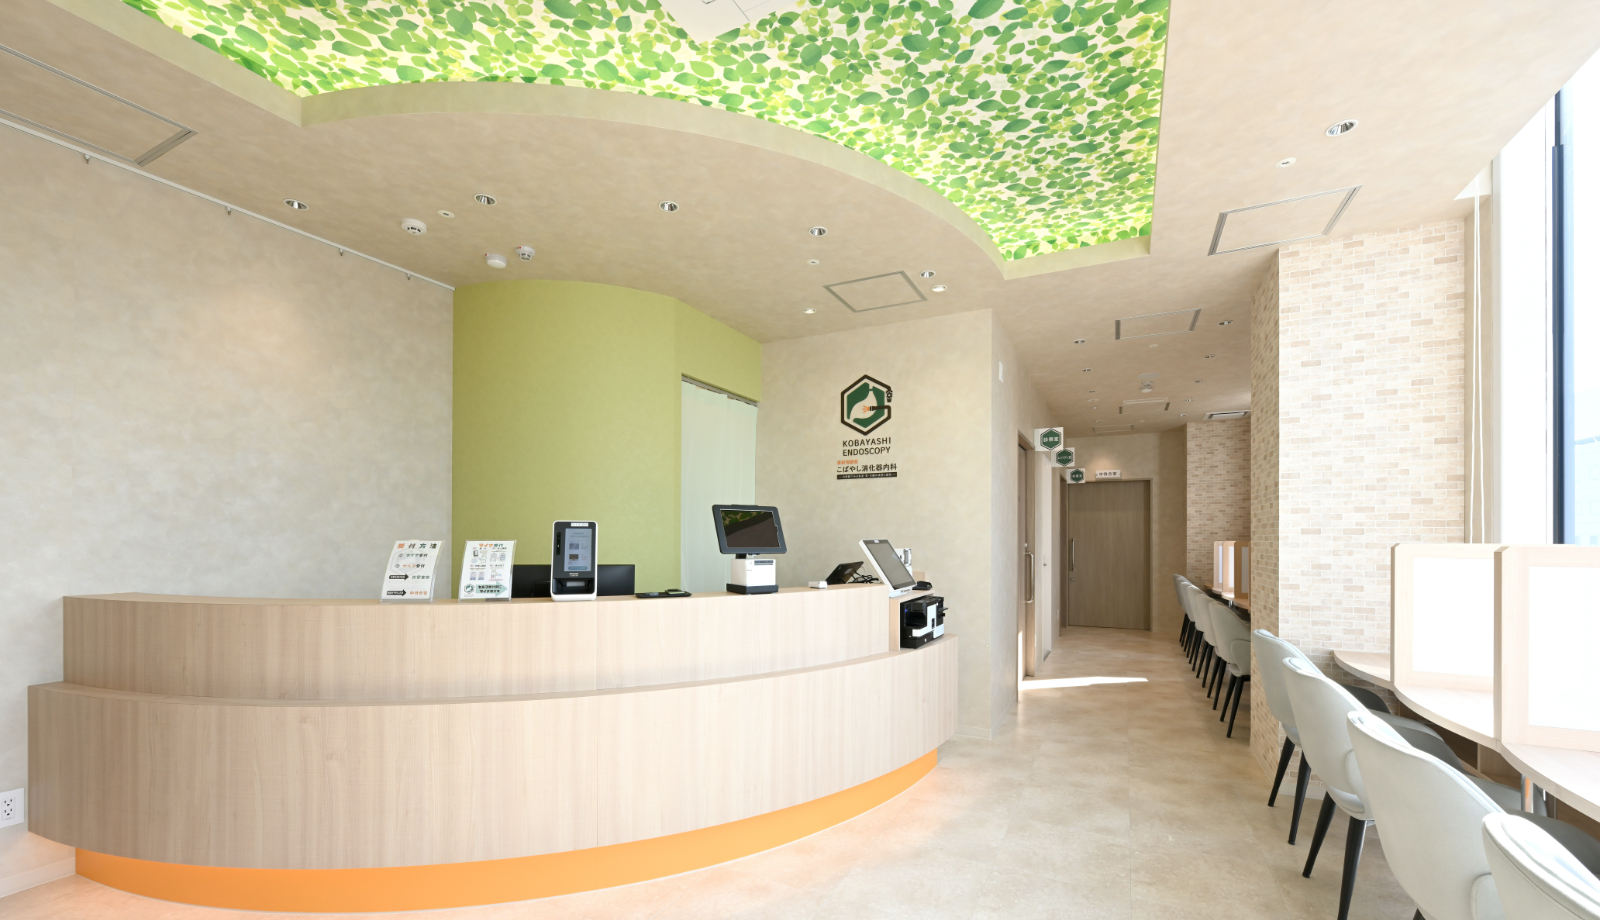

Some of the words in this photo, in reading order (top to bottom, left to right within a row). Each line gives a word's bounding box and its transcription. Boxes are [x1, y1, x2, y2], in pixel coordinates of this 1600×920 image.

[842, 437, 891, 448] KOBAYASHI
[842, 446, 891, 457] ENDOSCOPY
[837, 463, 897, 473] こばやし消化器内科
